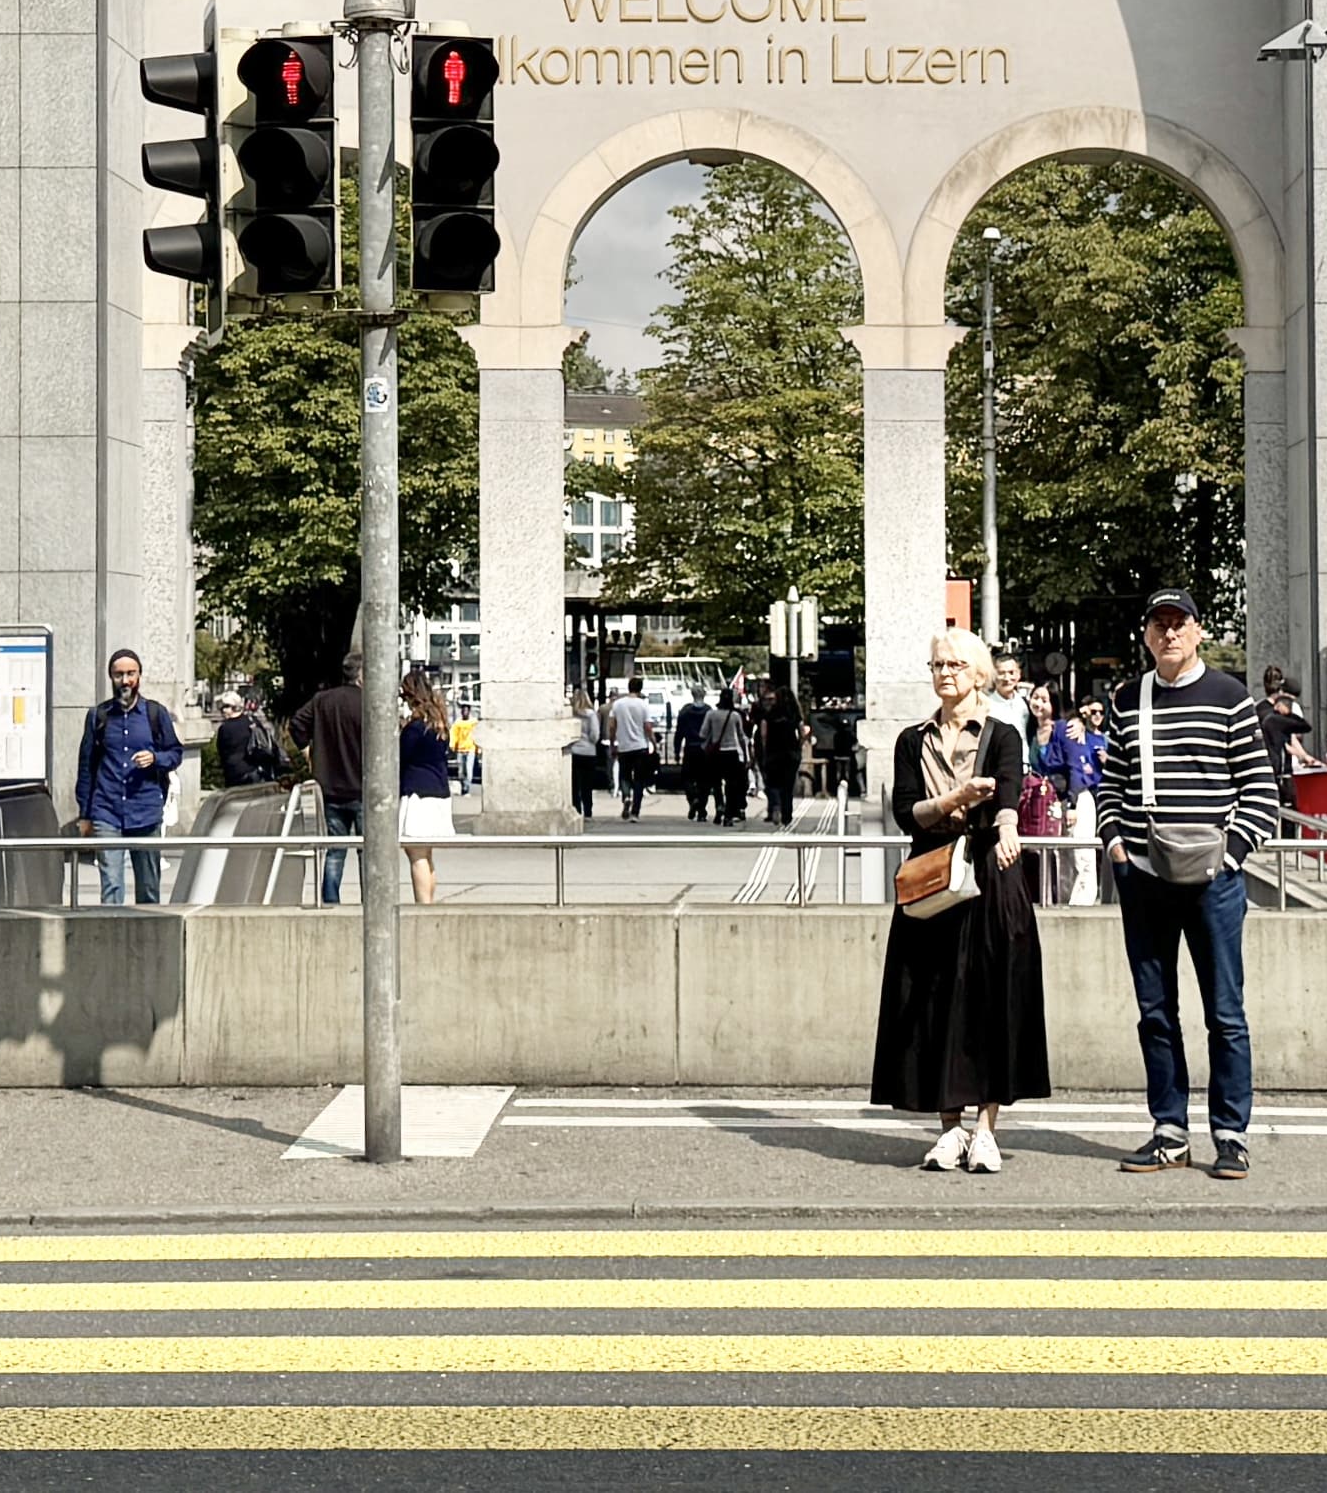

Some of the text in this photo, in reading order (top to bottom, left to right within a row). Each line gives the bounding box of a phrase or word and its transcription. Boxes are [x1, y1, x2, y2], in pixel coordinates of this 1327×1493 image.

[498, 34, 1010, 85] lkommen in Luzern
